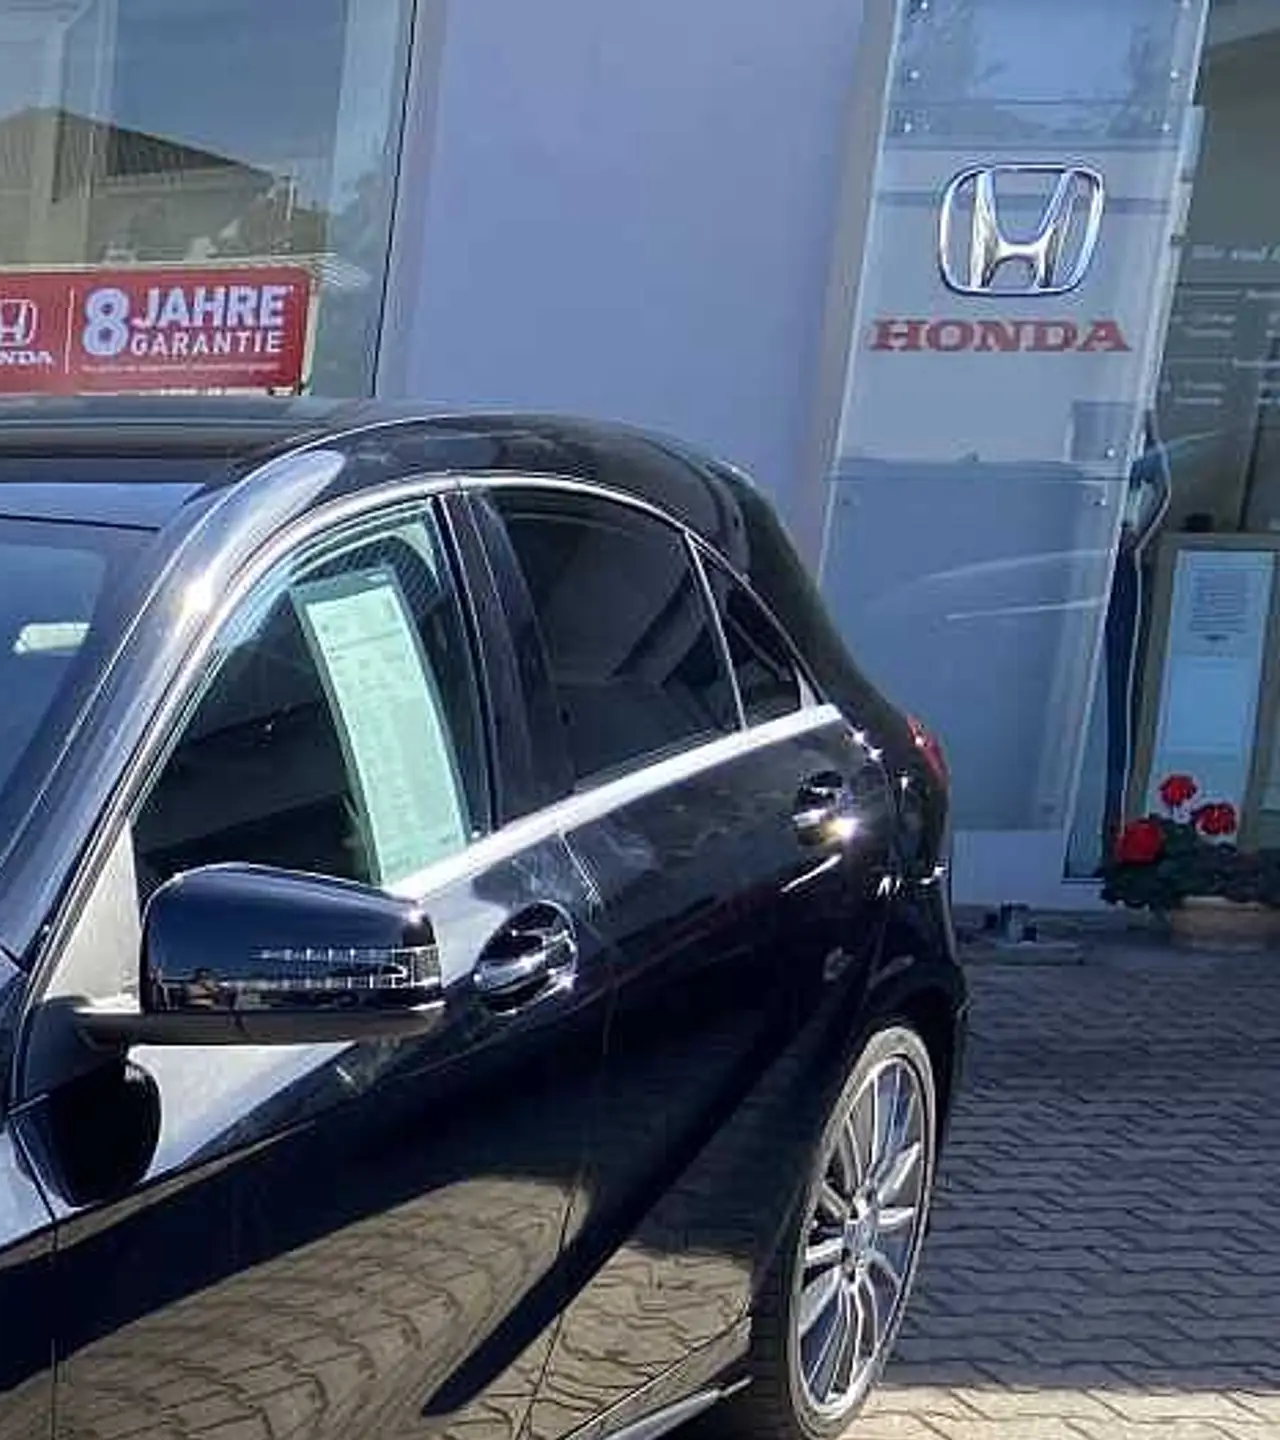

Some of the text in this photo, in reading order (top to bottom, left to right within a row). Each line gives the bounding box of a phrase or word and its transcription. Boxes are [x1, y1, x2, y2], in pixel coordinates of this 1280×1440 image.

[83, 285, 286, 356] 8 JAHRE
[869, 320, 1131, 352] HONDA
[130, 330, 283, 356] GARANTIE
